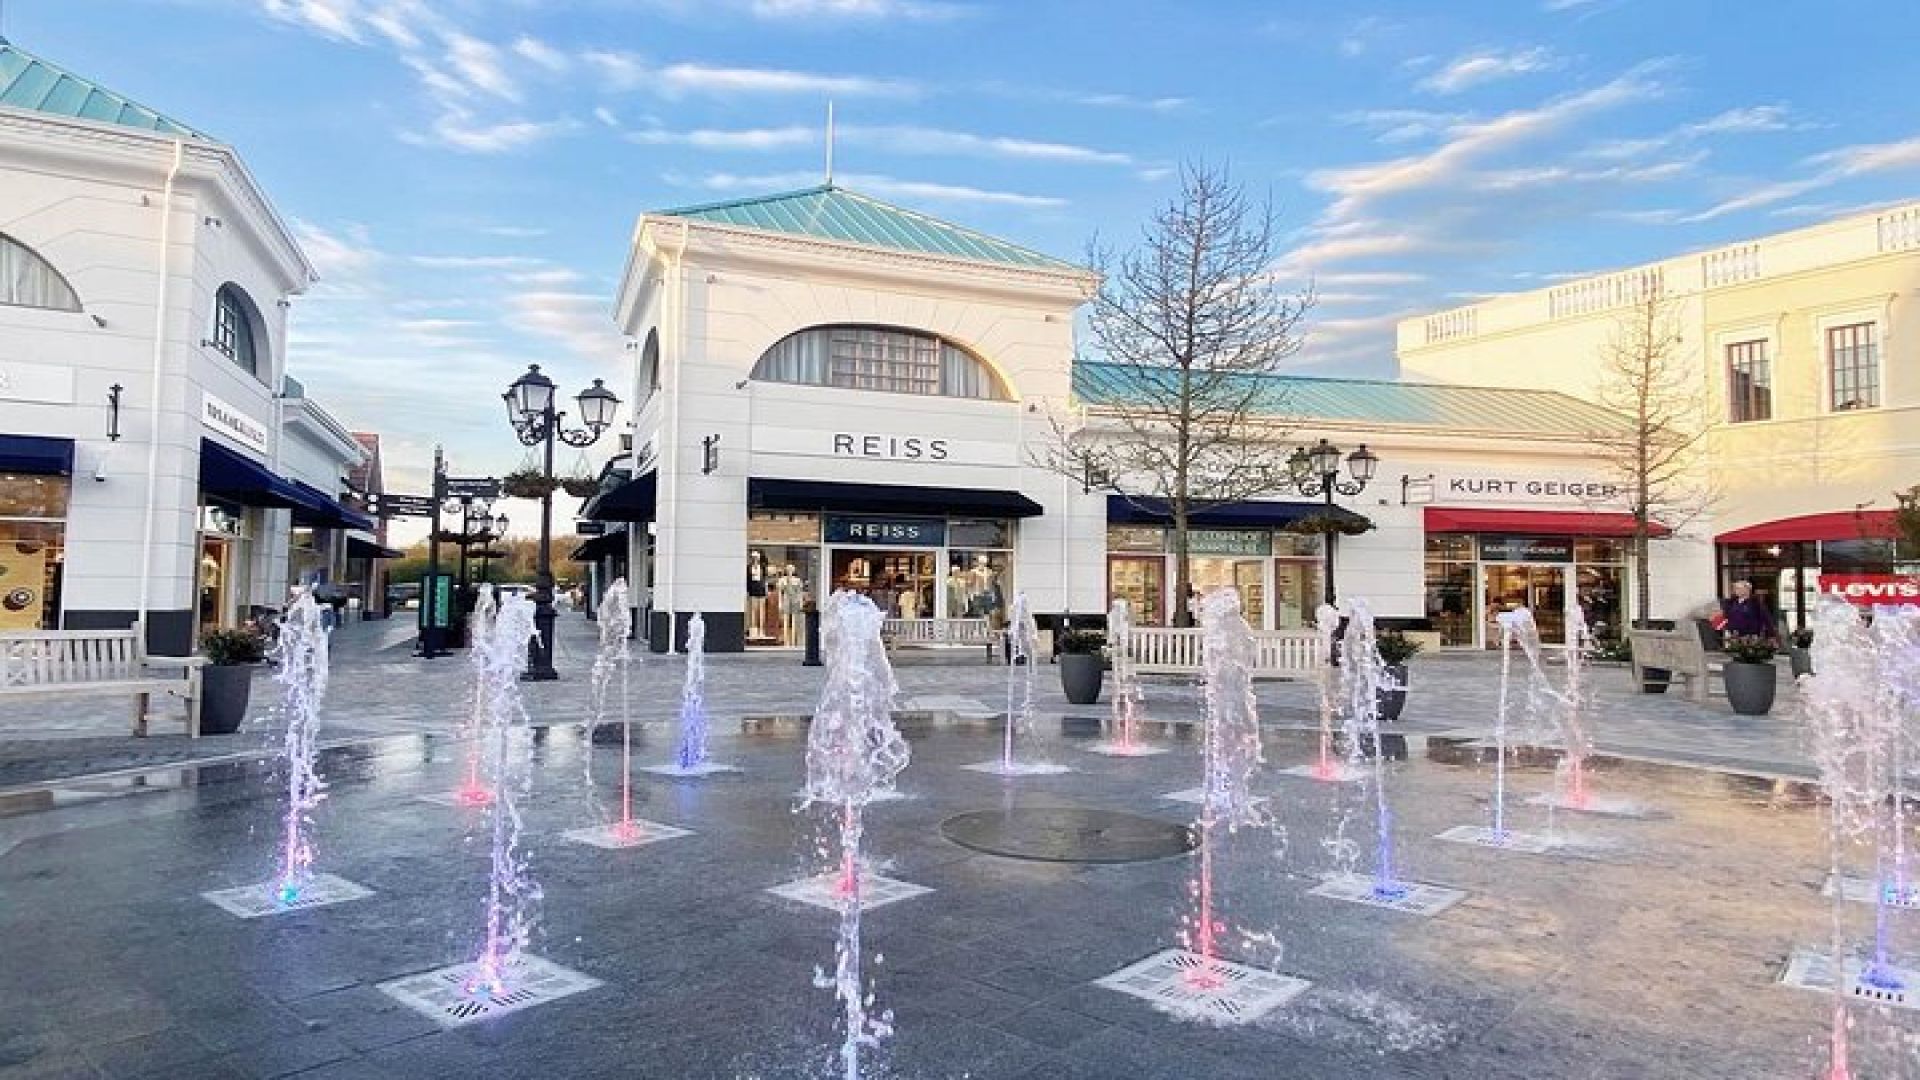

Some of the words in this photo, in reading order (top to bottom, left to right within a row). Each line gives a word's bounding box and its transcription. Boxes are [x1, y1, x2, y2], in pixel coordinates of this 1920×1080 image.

[834, 433, 948, 460] REISS
[1450, 478, 1518, 494] KURT
[1526, 481, 1617, 497] GEIGER
[849, 523, 921, 539] REISS
